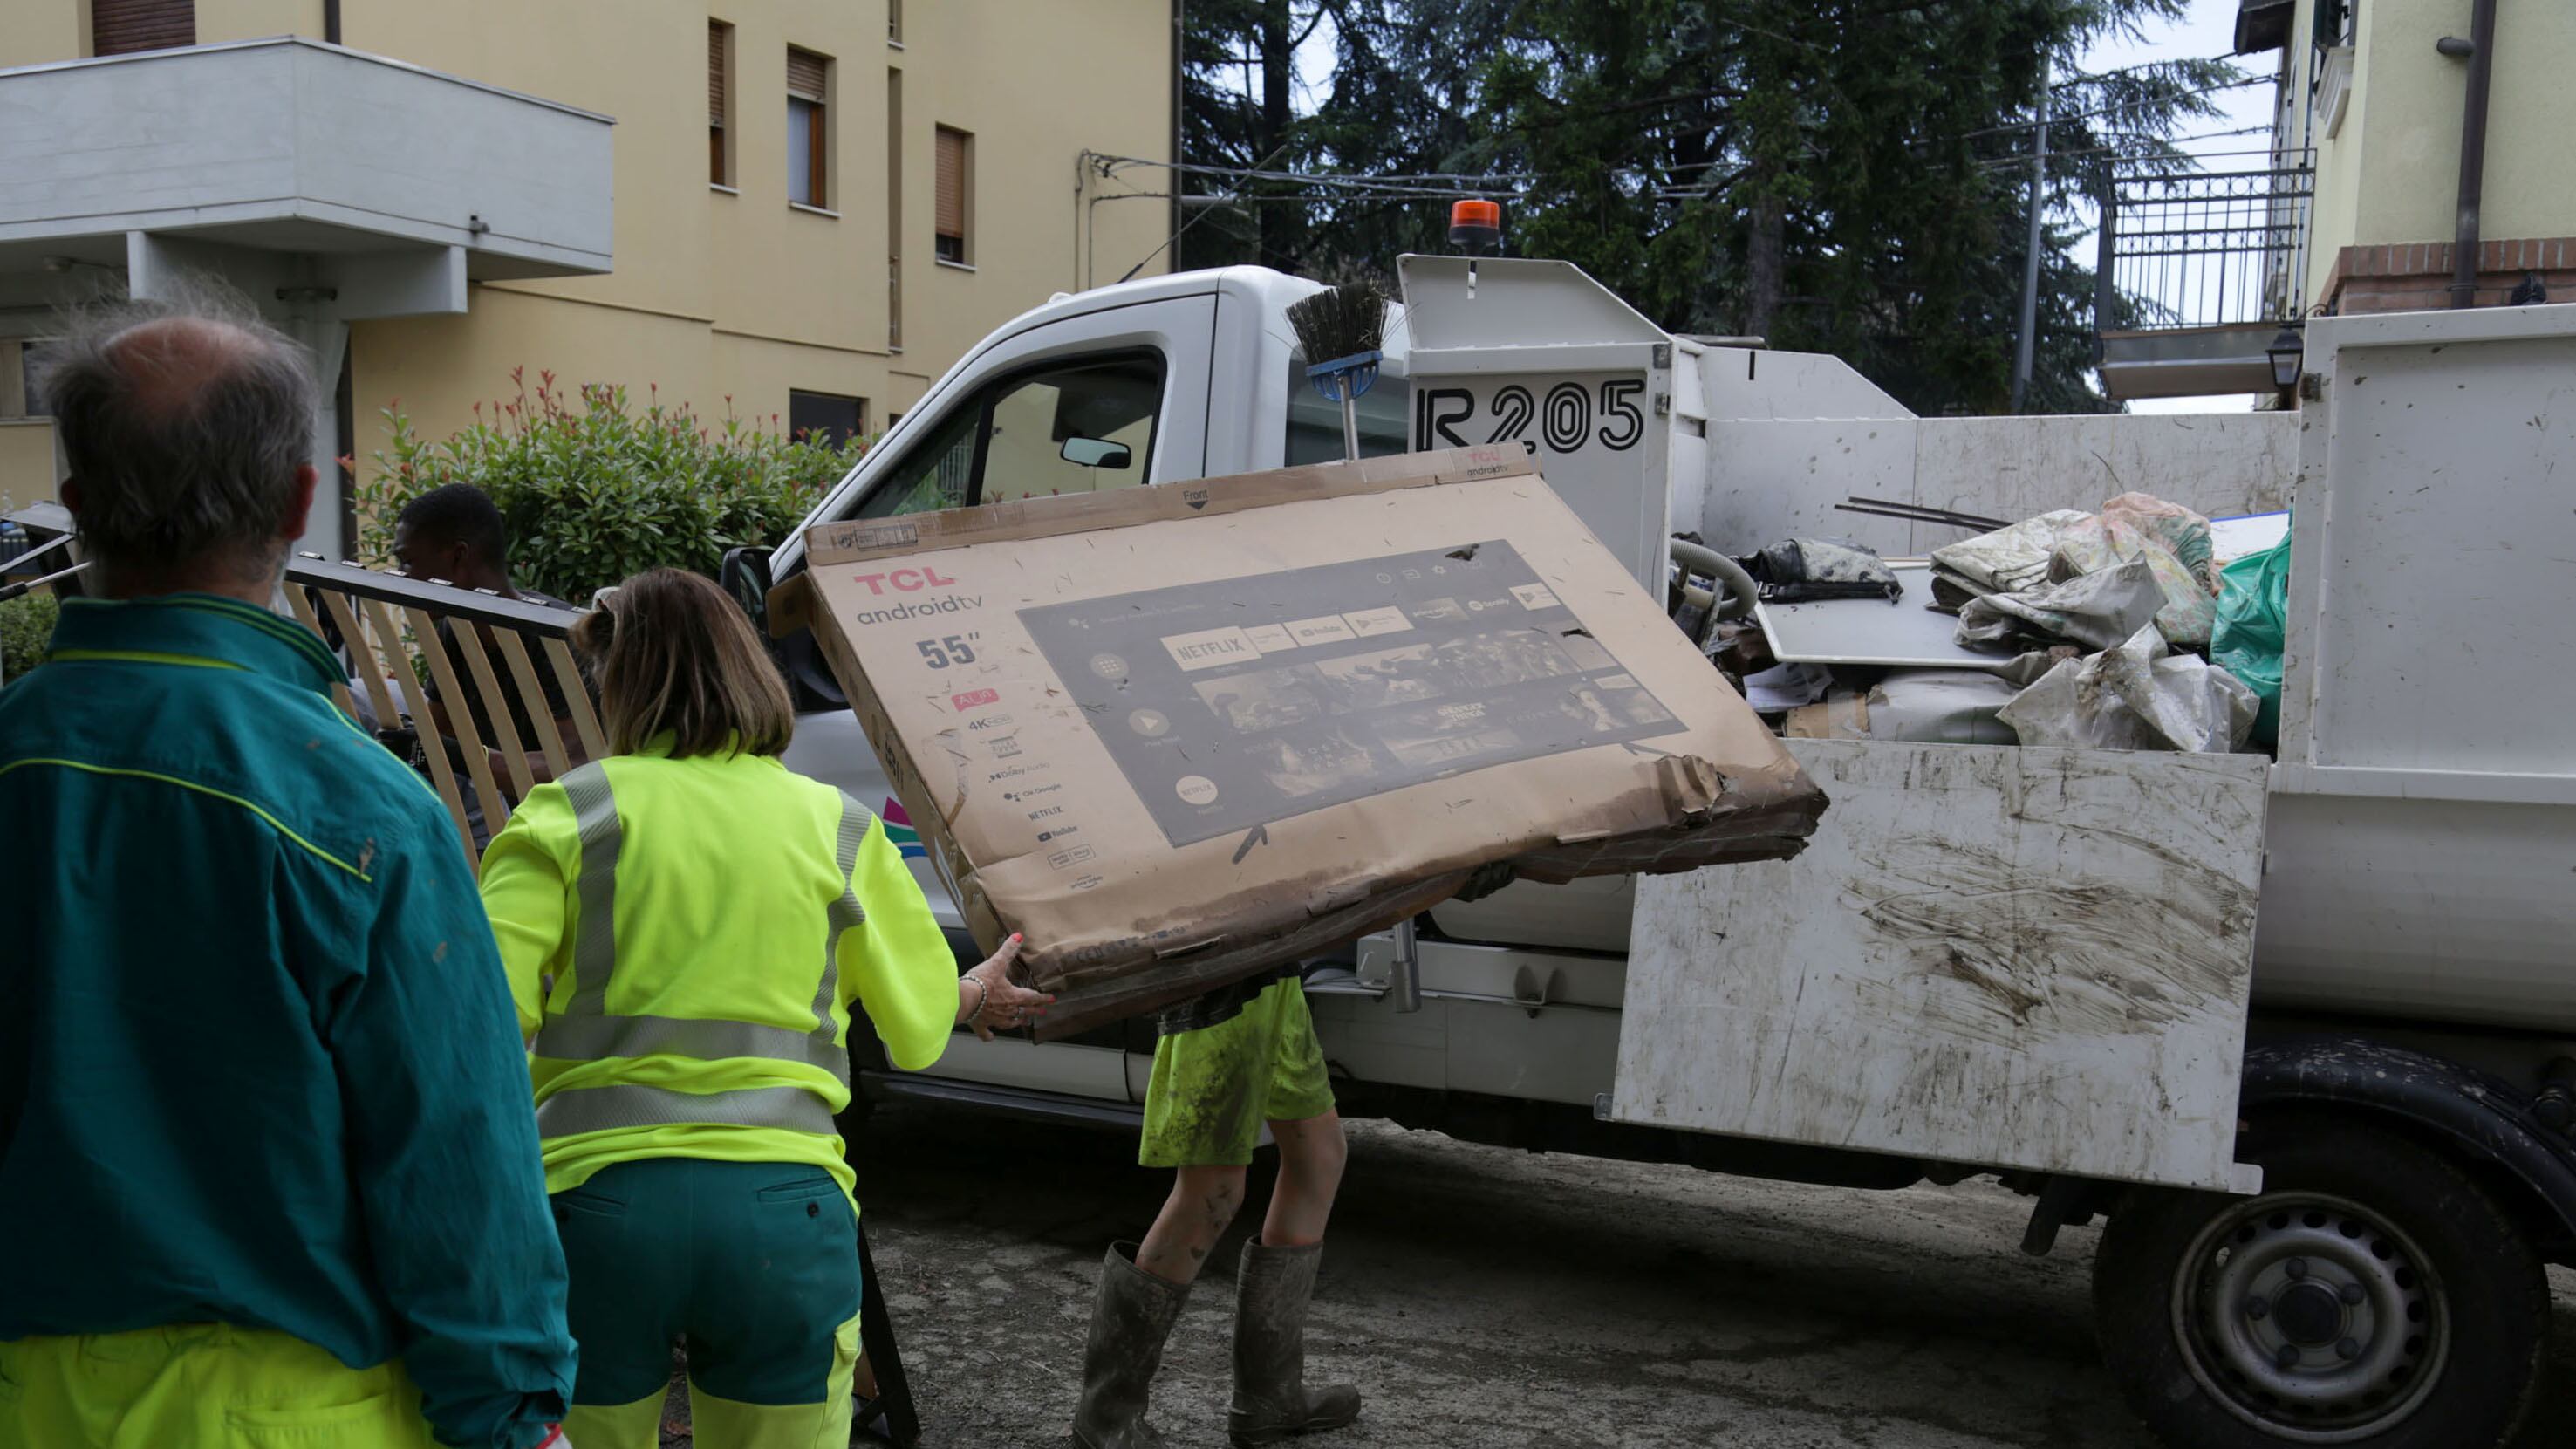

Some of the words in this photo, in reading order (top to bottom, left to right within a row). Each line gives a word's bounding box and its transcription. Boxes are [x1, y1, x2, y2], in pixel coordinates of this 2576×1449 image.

[1466, 451, 1502, 463] TCL
[1183, 489, 1208, 501] Front
[853, 567, 957, 595] TCL
[1177, 638, 1245, 660] NETFLIX
[969, 718, 990, 731] 4K
[1028, 806, 1063, 821] NETFLIX
[1052, 825, 1078, 837] YouTube
